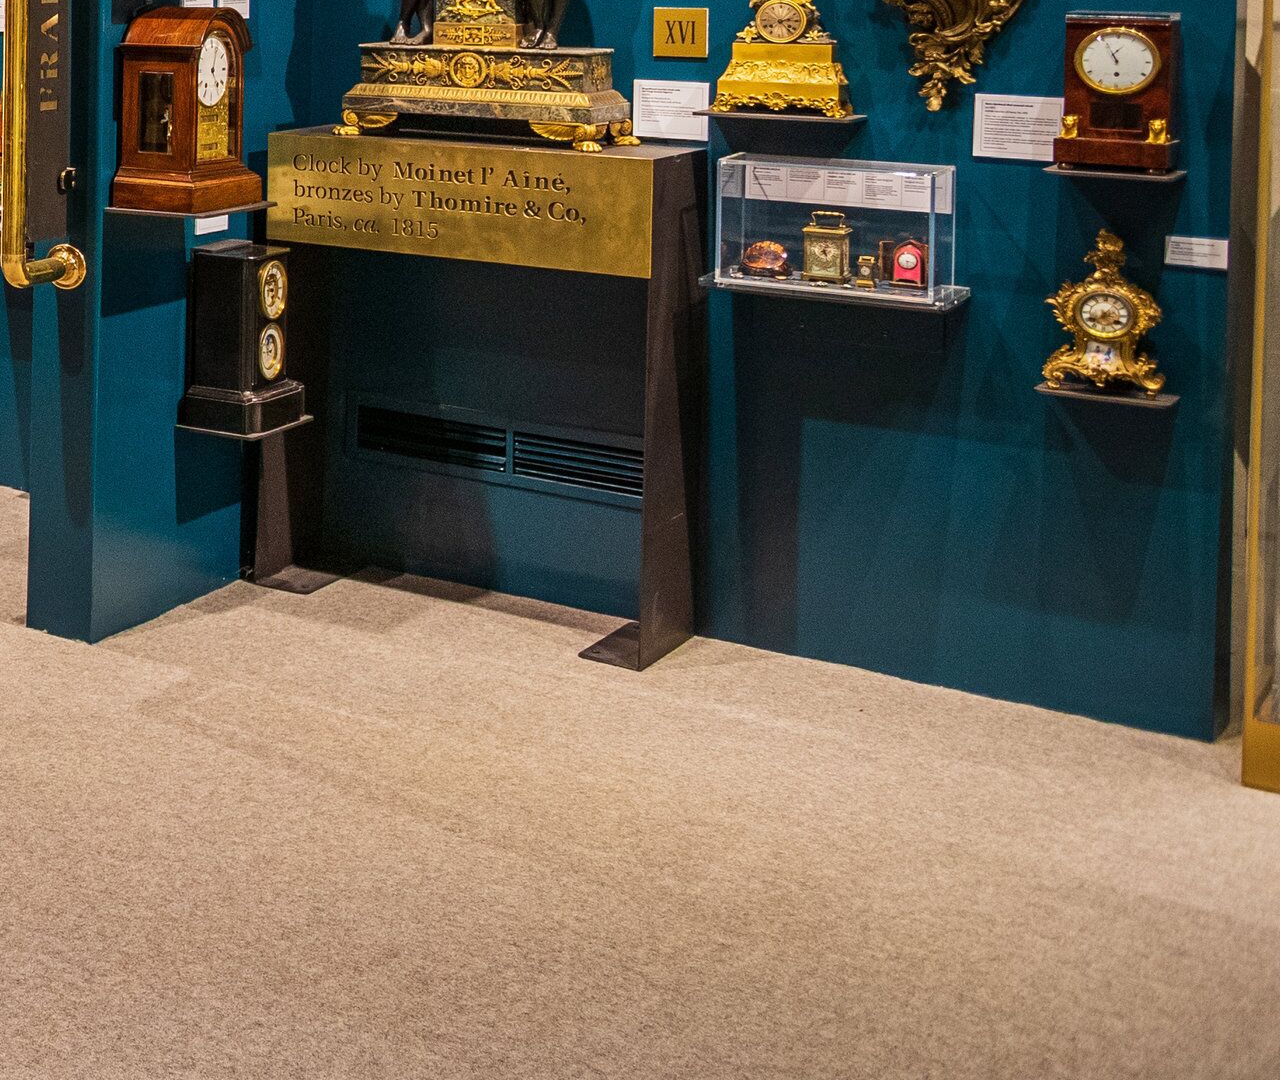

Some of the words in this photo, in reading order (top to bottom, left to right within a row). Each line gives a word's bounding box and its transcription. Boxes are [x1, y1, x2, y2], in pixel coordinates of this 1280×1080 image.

[665, 20, 696, 44] XVI
[292, 153, 350, 175] Clock
[357, 157, 383, 182] by
[392, 161, 474, 186] Moinet
[292, 180, 373, 204] bronzes
[380, 181, 404, 210] by
[412, 189, 517, 217] Thomire
[523, 200, 541, 219] &
[547, 200, 587, 226] Co,
[292, 207, 346, 231] Paris,
[353, 217, 380, 234] ca.
[391, 217, 439, 240] 1815
